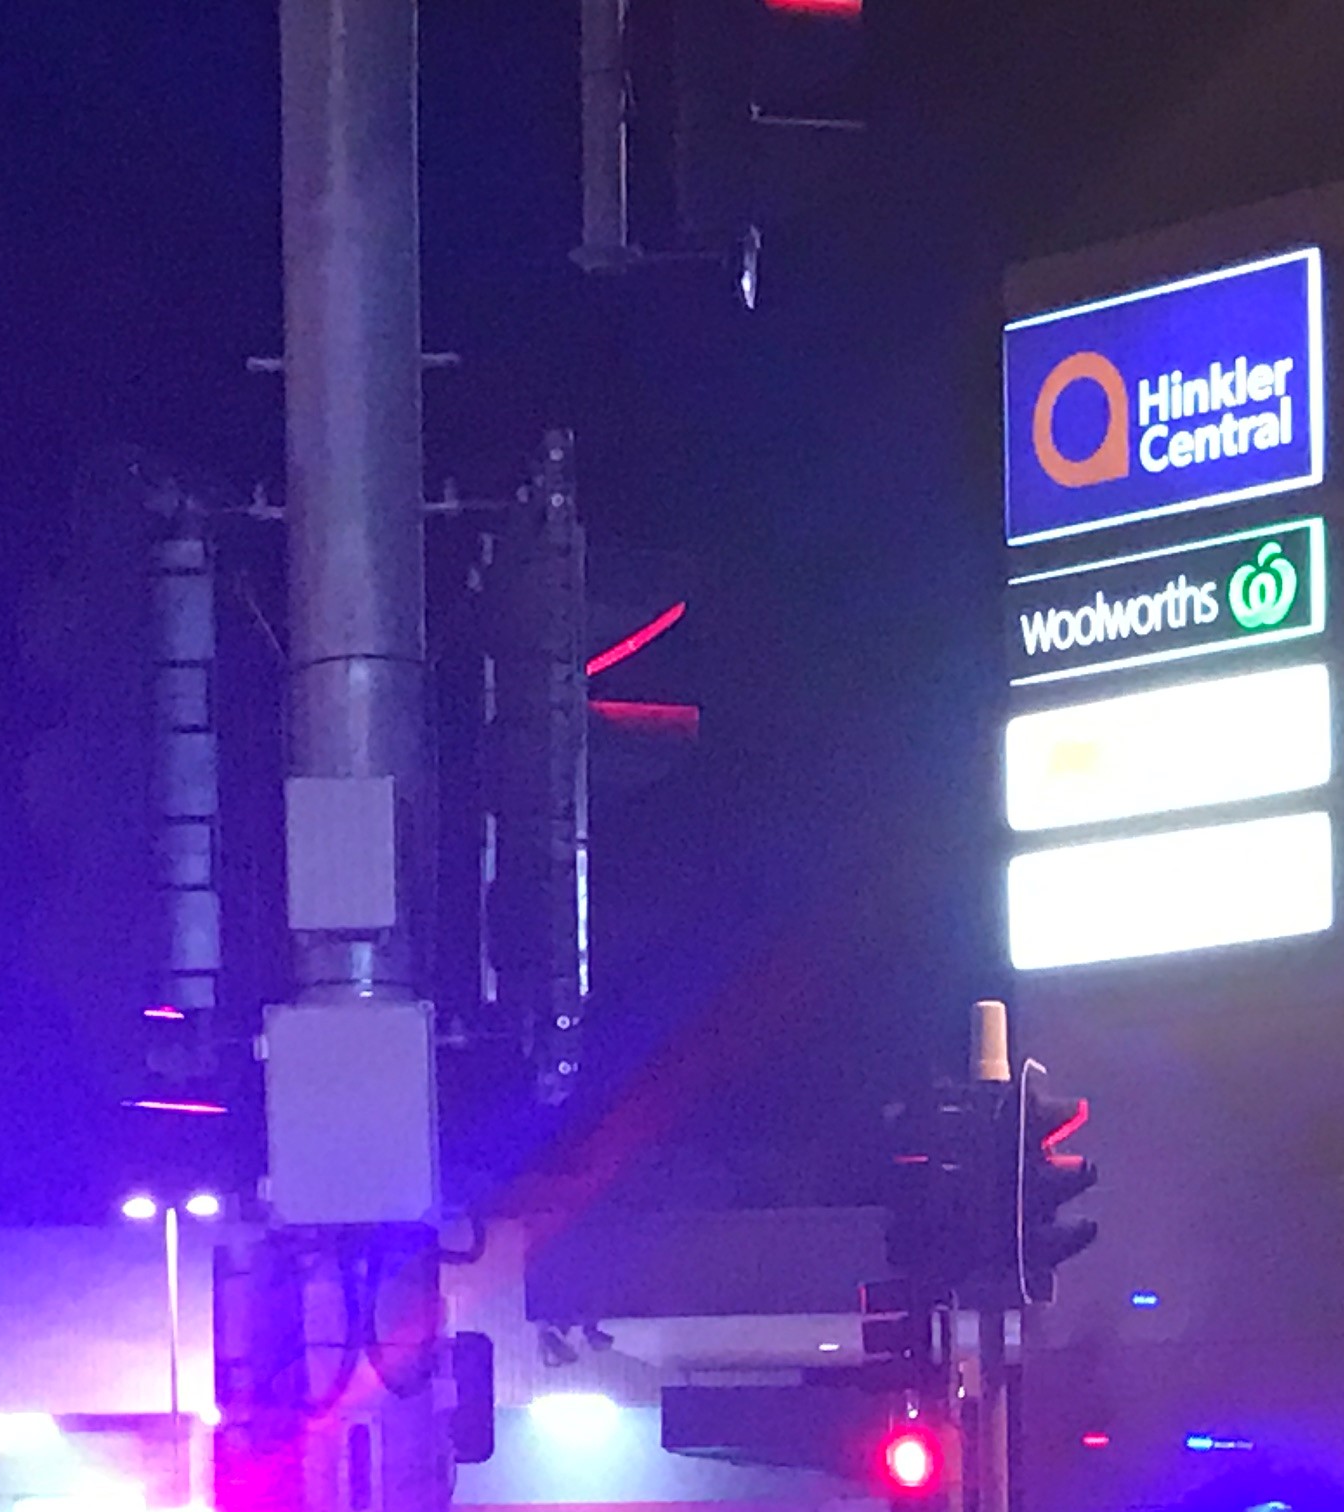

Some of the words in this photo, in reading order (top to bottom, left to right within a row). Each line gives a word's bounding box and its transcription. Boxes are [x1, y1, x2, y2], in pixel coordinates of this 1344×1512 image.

[1138, 356, 1293, 428] Hinkler
[1139, 397, 1292, 472] Central
[1021, 573, 1219, 656] Woolworths
